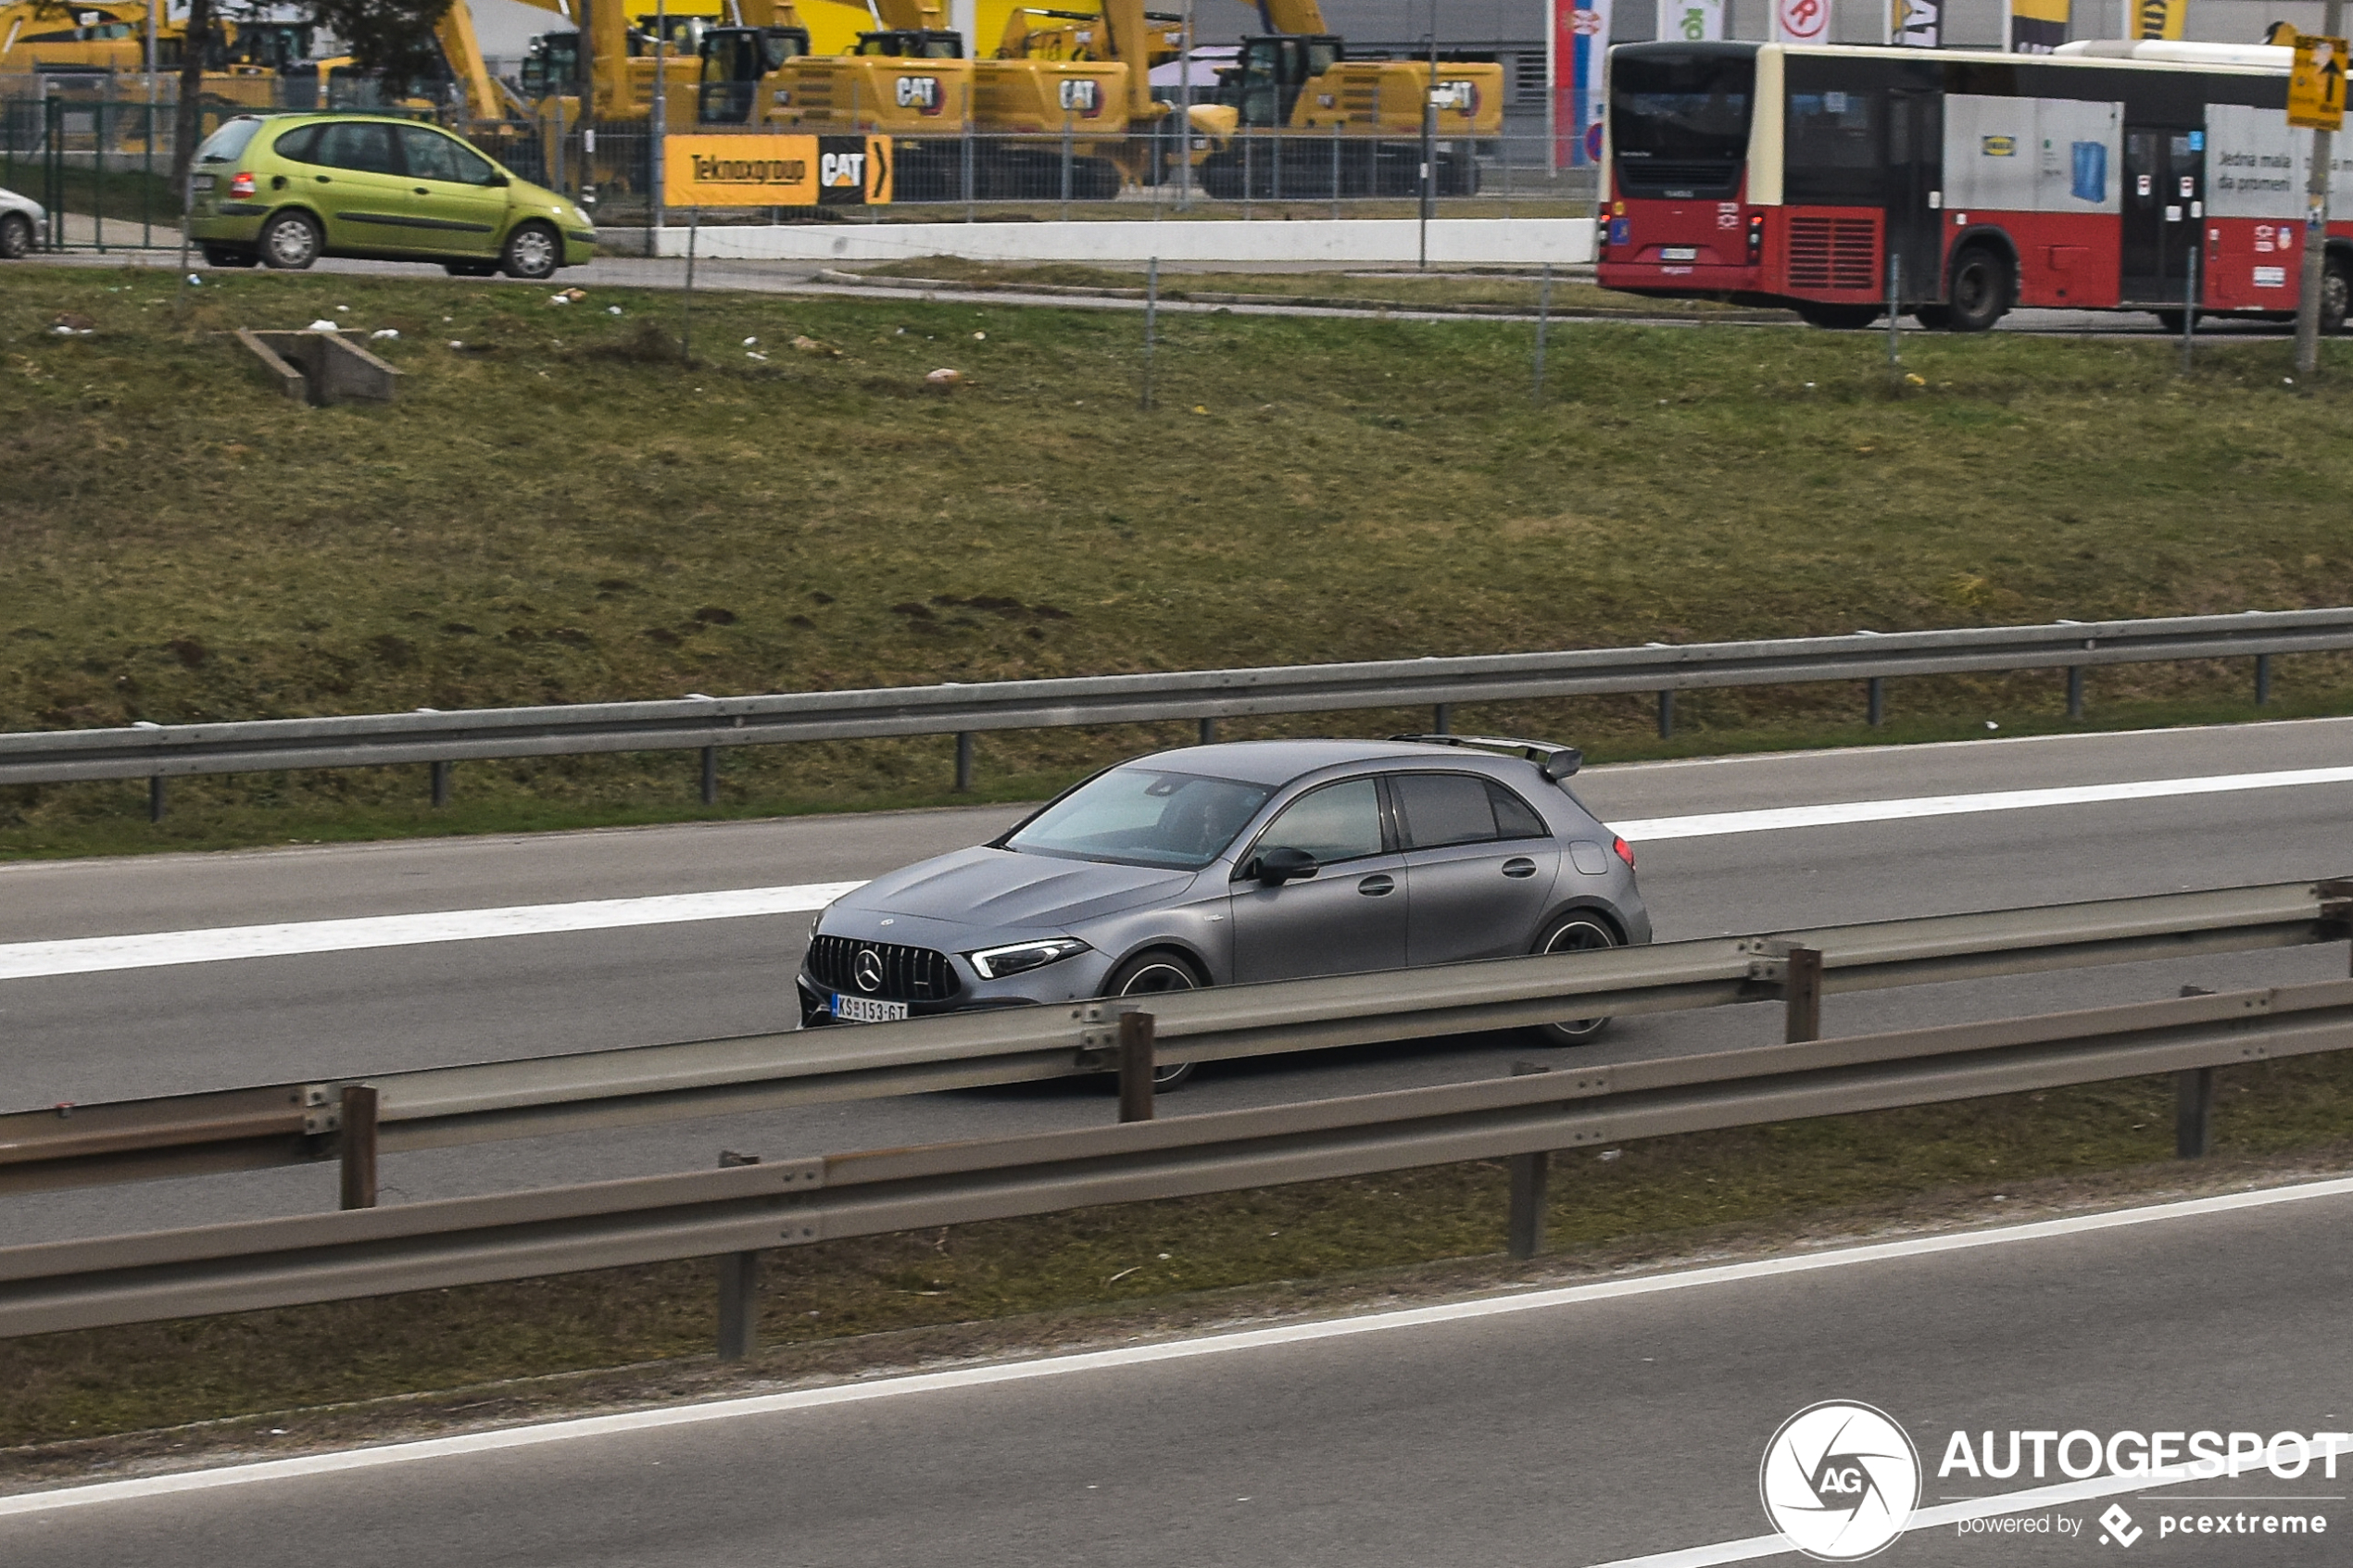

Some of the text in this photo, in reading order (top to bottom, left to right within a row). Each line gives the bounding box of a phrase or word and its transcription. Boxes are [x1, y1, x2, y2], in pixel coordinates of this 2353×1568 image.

[896, 77, 935, 107] CAT
[1060, 80, 1094, 109] CAT
[691, 152, 865, 186] Teknoxgroup CAT
